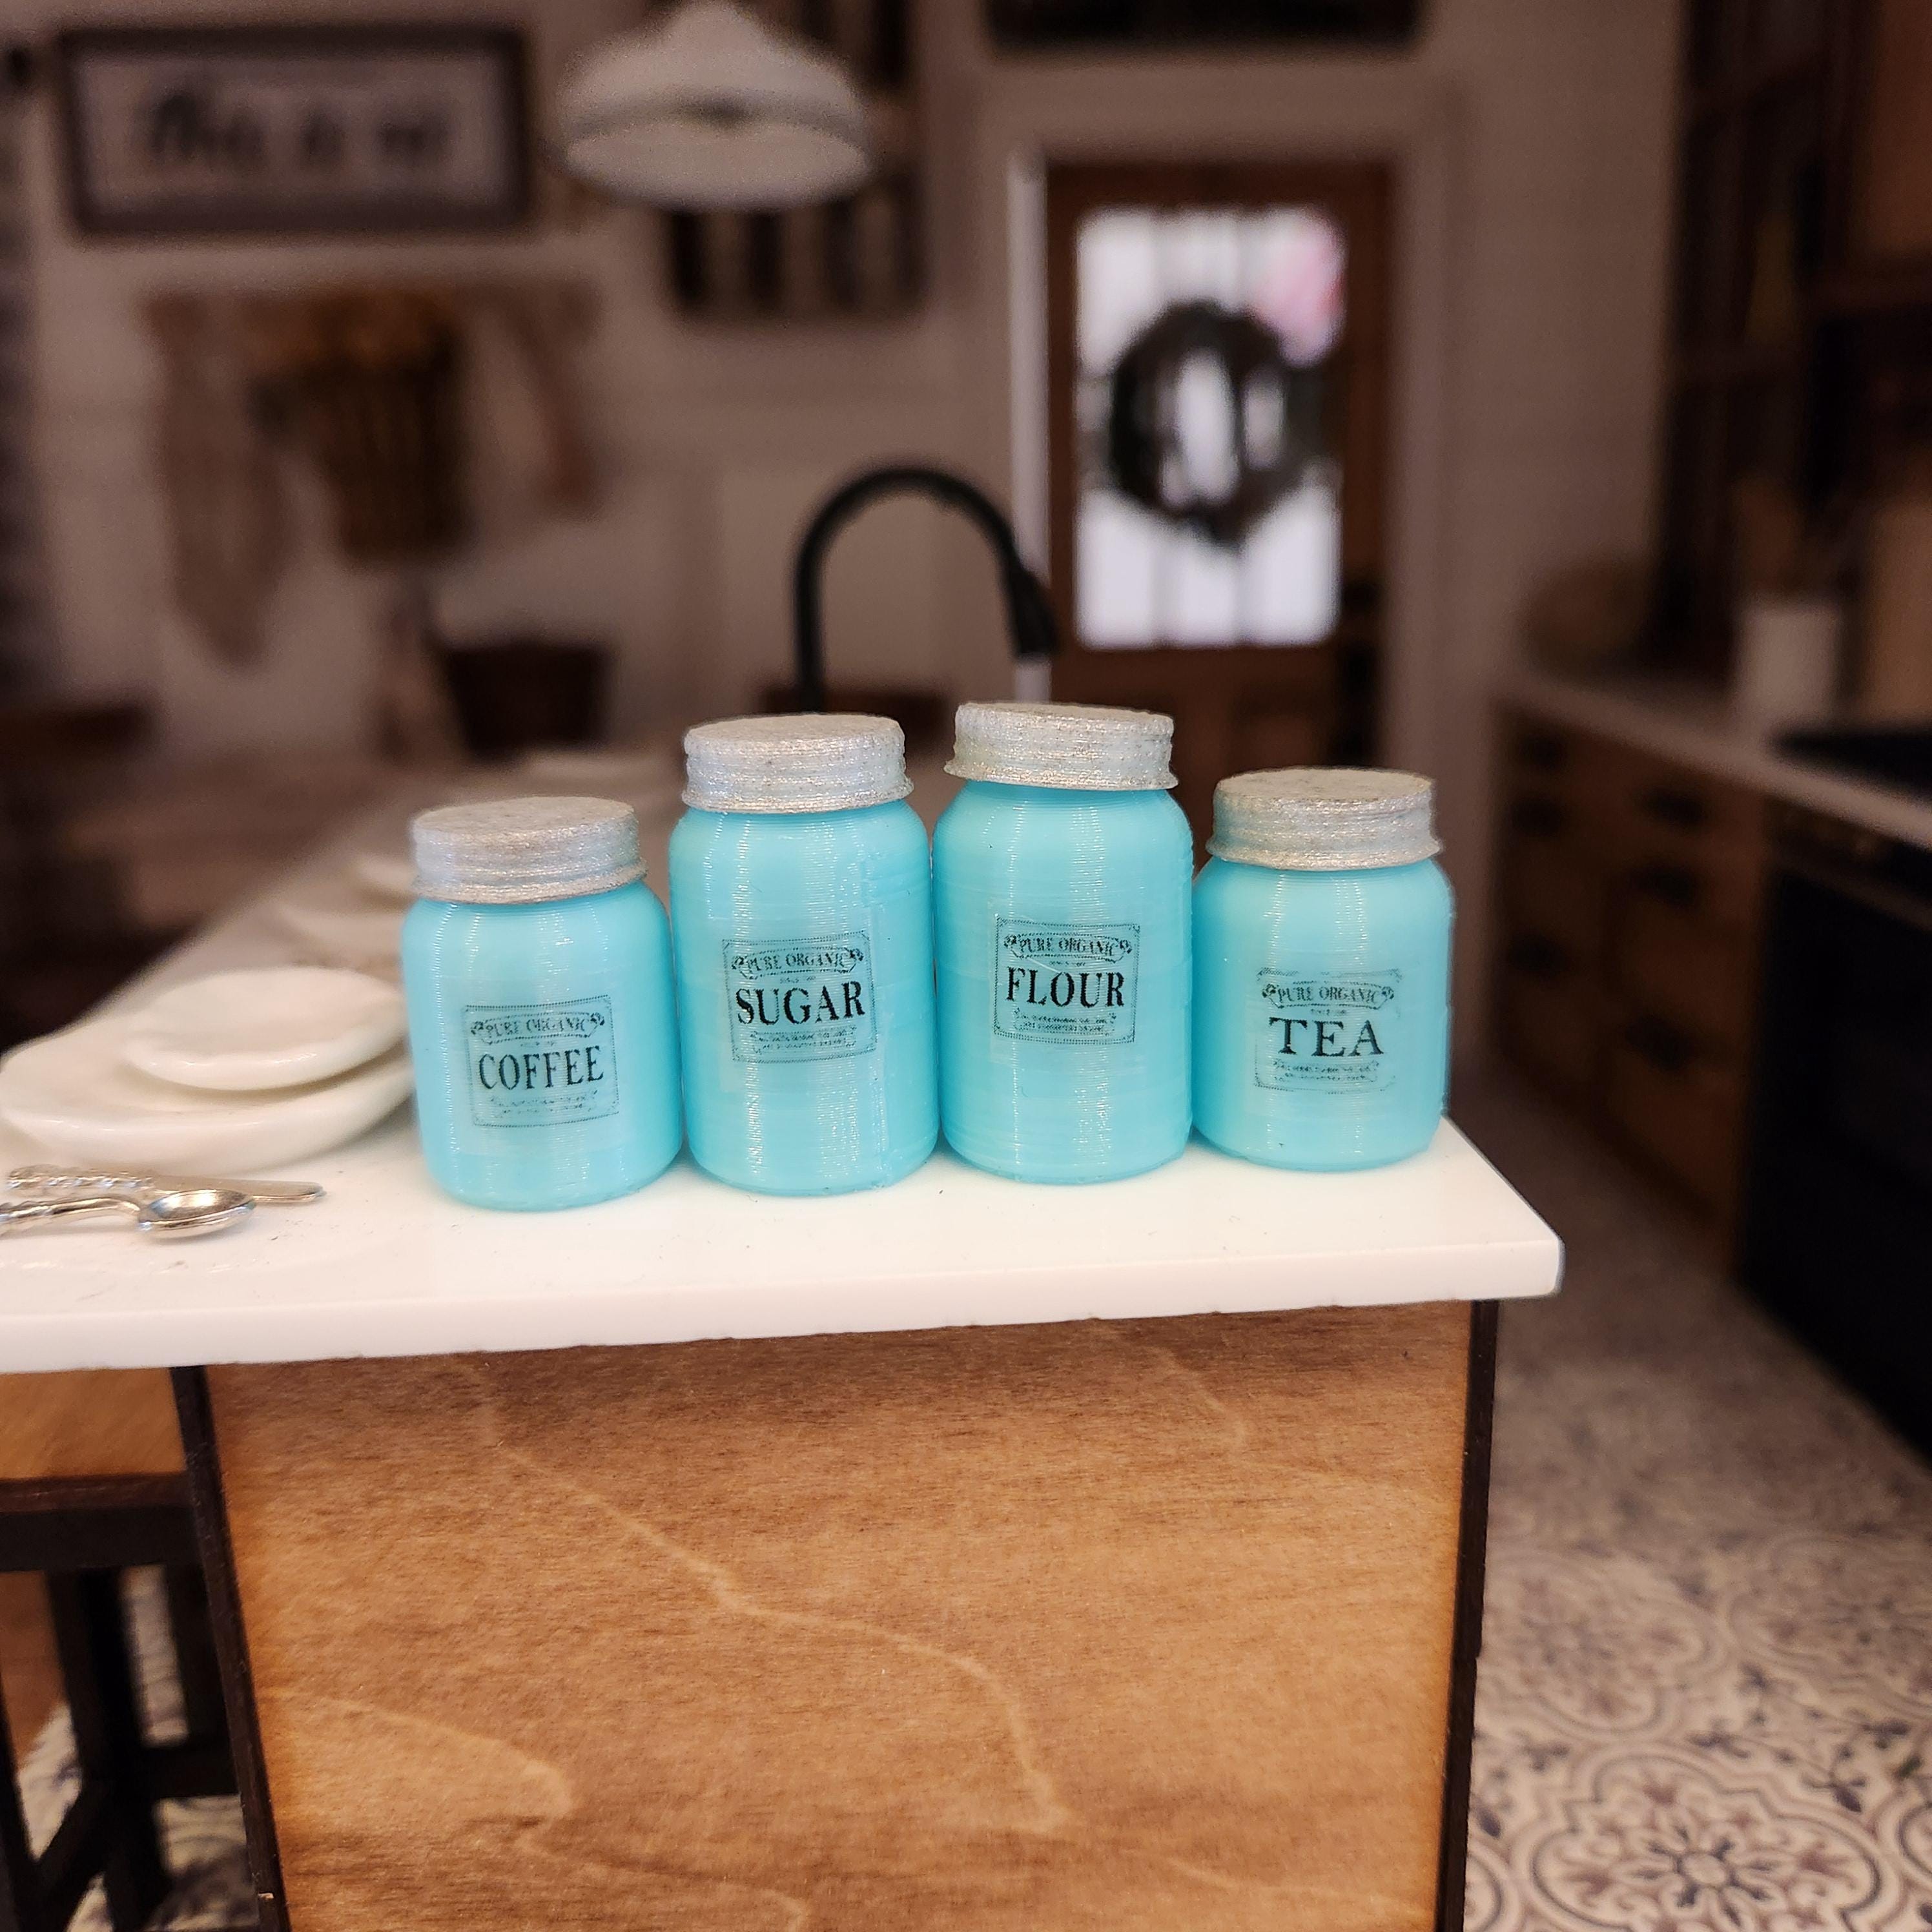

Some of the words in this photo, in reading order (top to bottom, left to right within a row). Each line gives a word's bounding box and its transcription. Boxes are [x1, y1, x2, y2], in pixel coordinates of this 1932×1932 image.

[785, 952, 848, 969] ORGANIC
[1020, 938, 1053, 953] PURE
[1058, 938, 1115, 956] ORGANIC
[735, 981, 865, 1025] SUGAR
[1006, 967, 1124, 1008] FLOUR
[1277, 987, 1313, 1002] PURE
[1319, 986, 1381, 1003] ORGANIC
[1269, 1016, 1384, 1056] TEA
[478, 1045, 603, 1090] COFFEE
